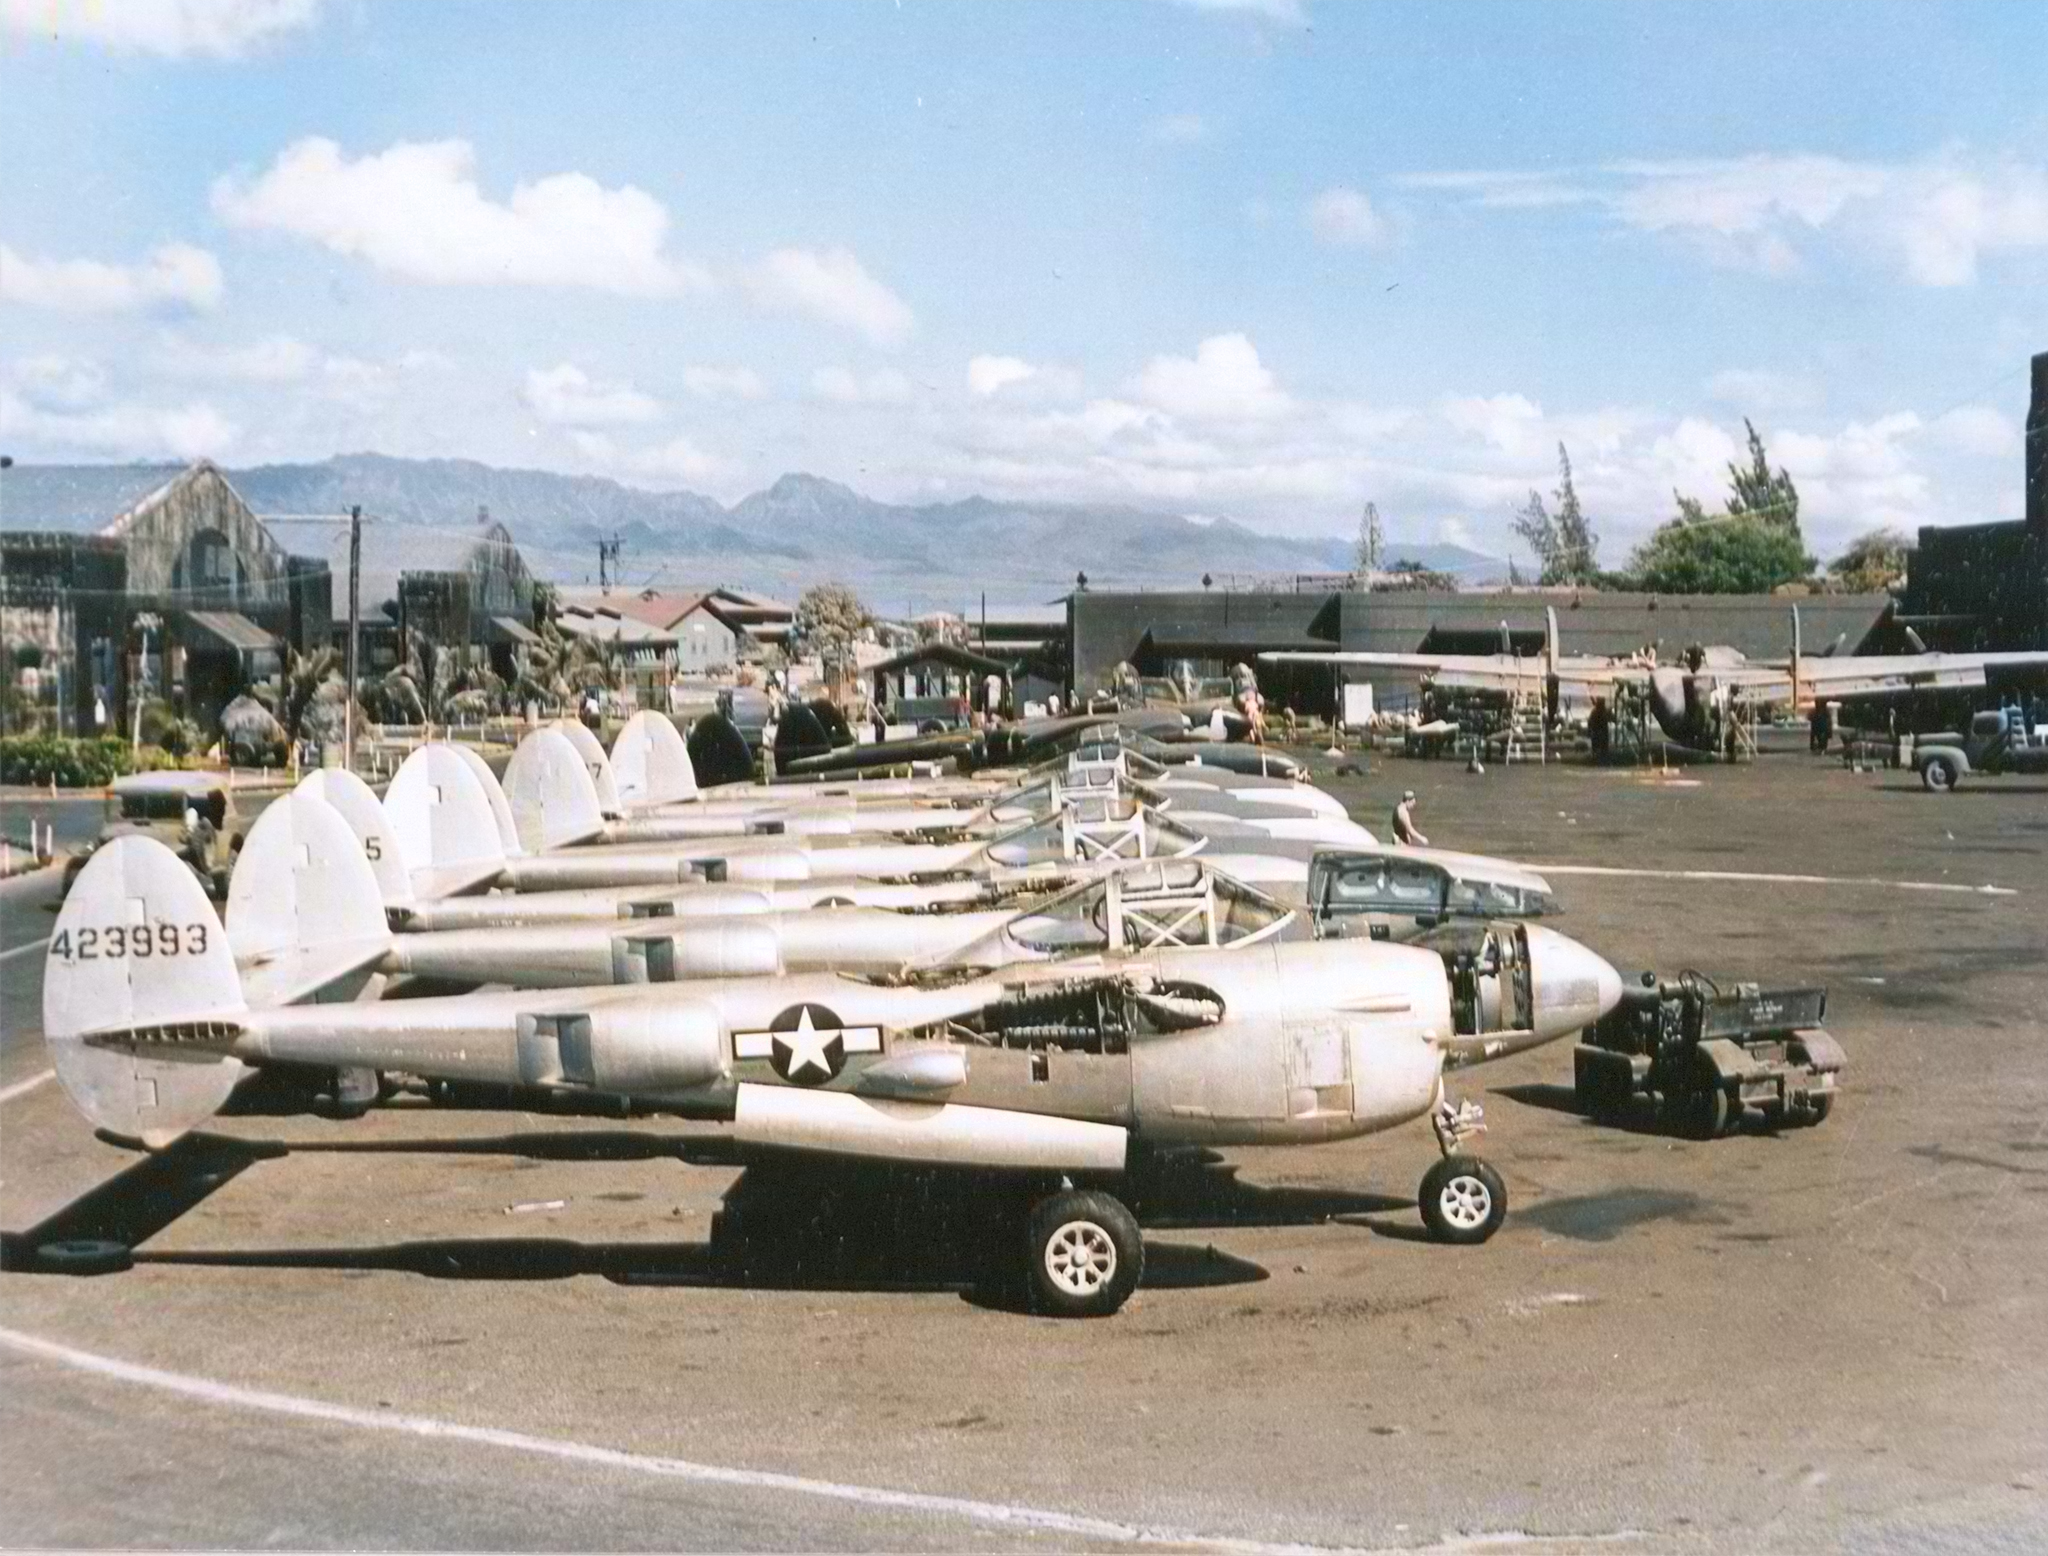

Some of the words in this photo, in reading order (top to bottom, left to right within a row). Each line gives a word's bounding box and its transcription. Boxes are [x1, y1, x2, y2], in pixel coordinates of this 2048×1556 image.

[585, 762, 602, 779] 7
[365, 836, 381, 861] 5
[50, 923, 208, 960] 423993
